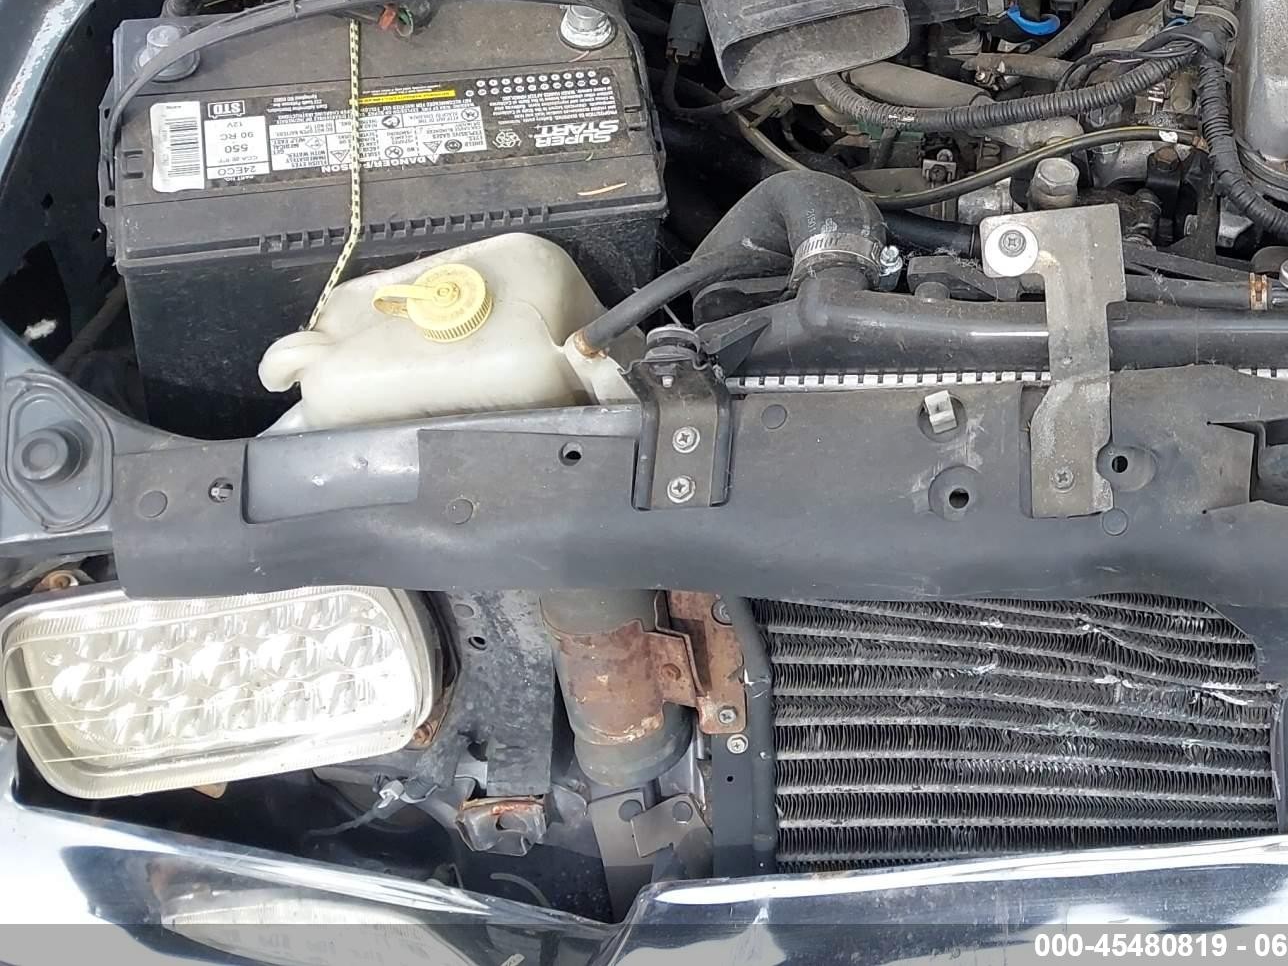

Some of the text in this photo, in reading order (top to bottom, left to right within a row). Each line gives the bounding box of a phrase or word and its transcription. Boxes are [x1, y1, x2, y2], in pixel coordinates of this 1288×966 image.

[213, 103, 241, 114] STD
[534, 120, 620, 138] START
[535, 133, 612, 148] SUPER
[224, 144, 248, 153] 550
